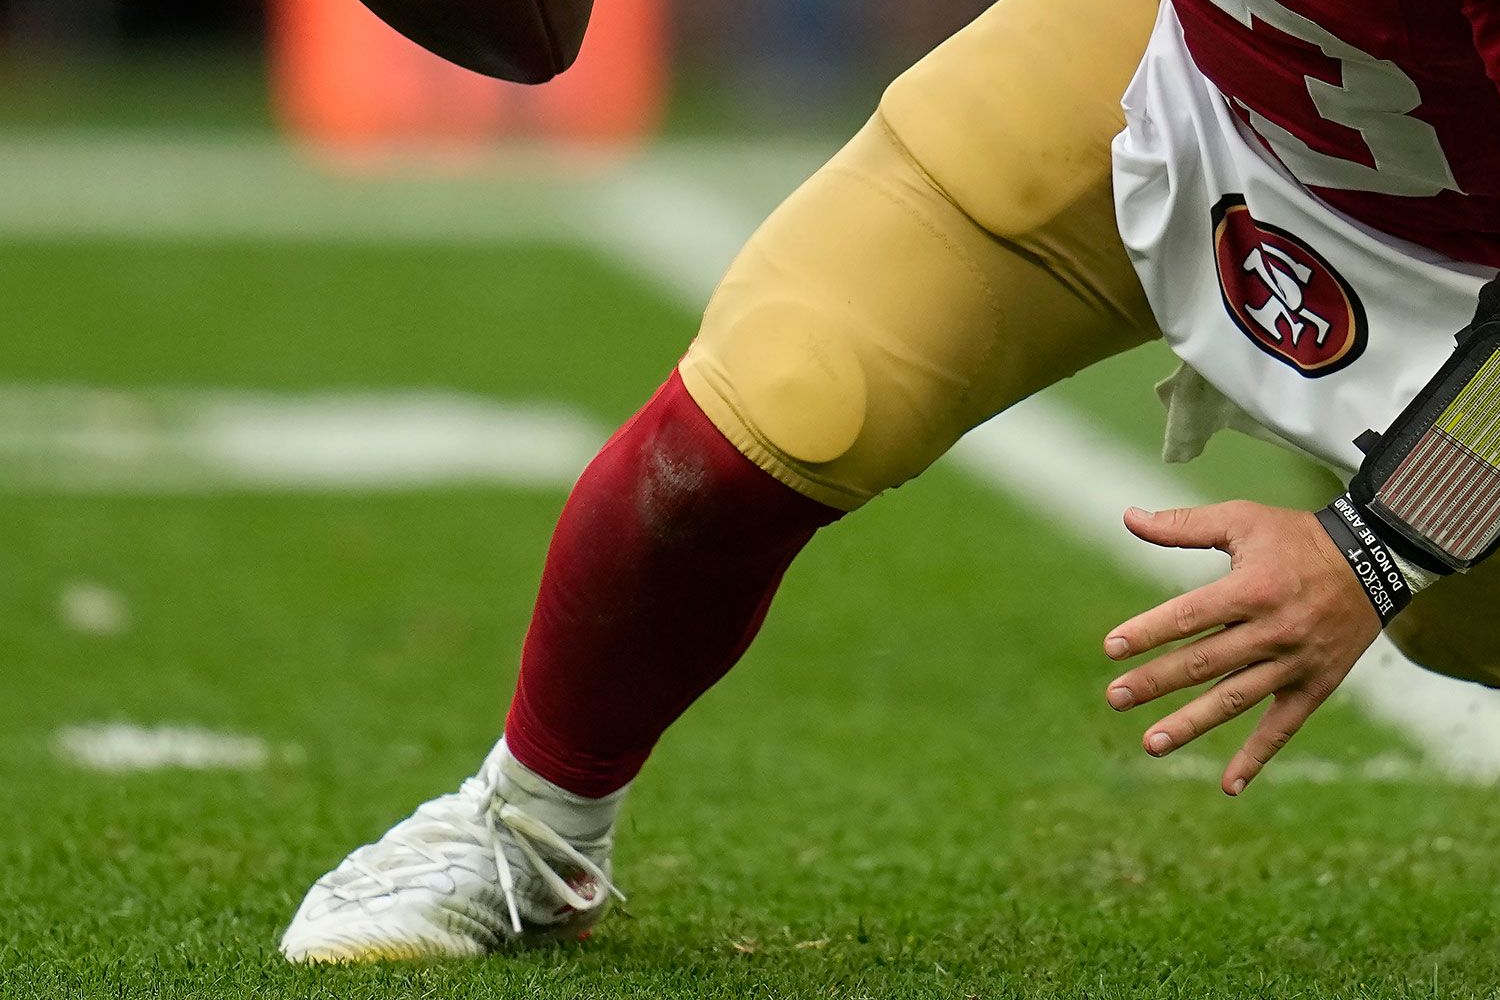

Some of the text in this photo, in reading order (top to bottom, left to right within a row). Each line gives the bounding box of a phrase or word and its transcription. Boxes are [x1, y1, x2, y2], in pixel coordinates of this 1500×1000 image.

[1334, 498, 1404, 592] DO NOT BE AFRAID
